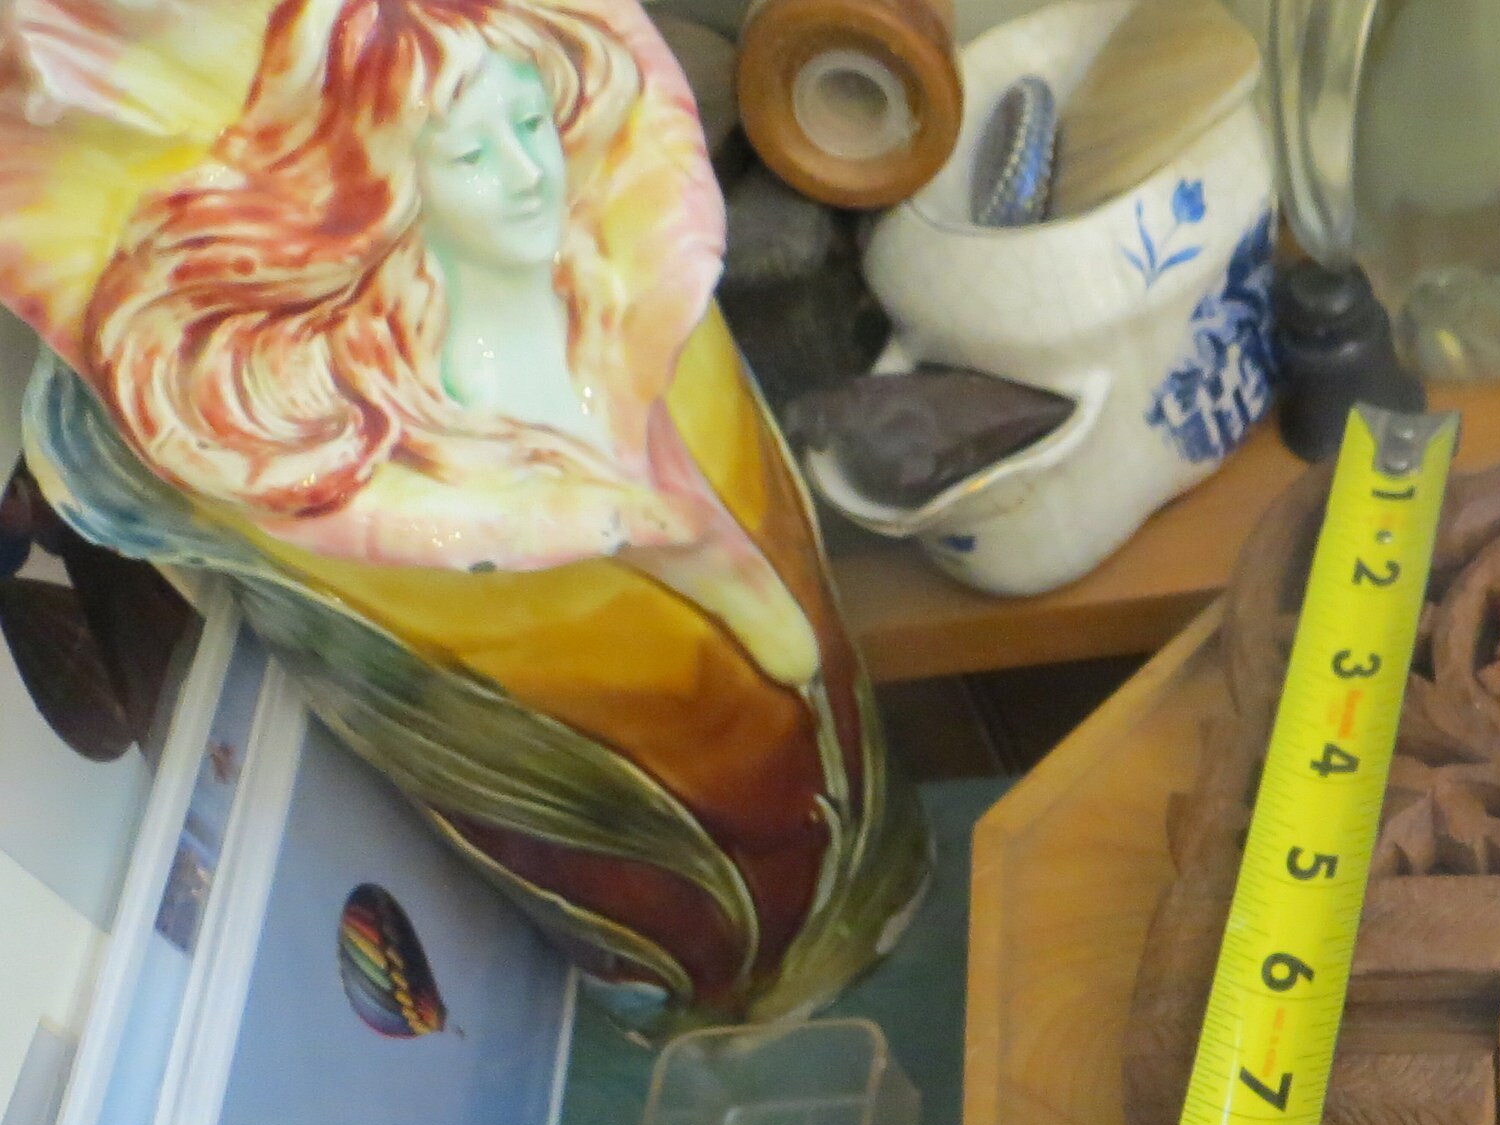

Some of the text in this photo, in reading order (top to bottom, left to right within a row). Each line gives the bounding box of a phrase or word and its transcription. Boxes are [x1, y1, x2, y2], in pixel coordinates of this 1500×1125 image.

[1371, 484, 1417, 502] 1
[1351, 557, 1400, 587] 2
[1331, 648, 1383, 680] 3
[1310, 742, 1360, 778] 4
[1286, 845, 1340, 881] 5
[1261, 951, 1315, 993] 6
[1239, 1066, 1293, 1113] 7
